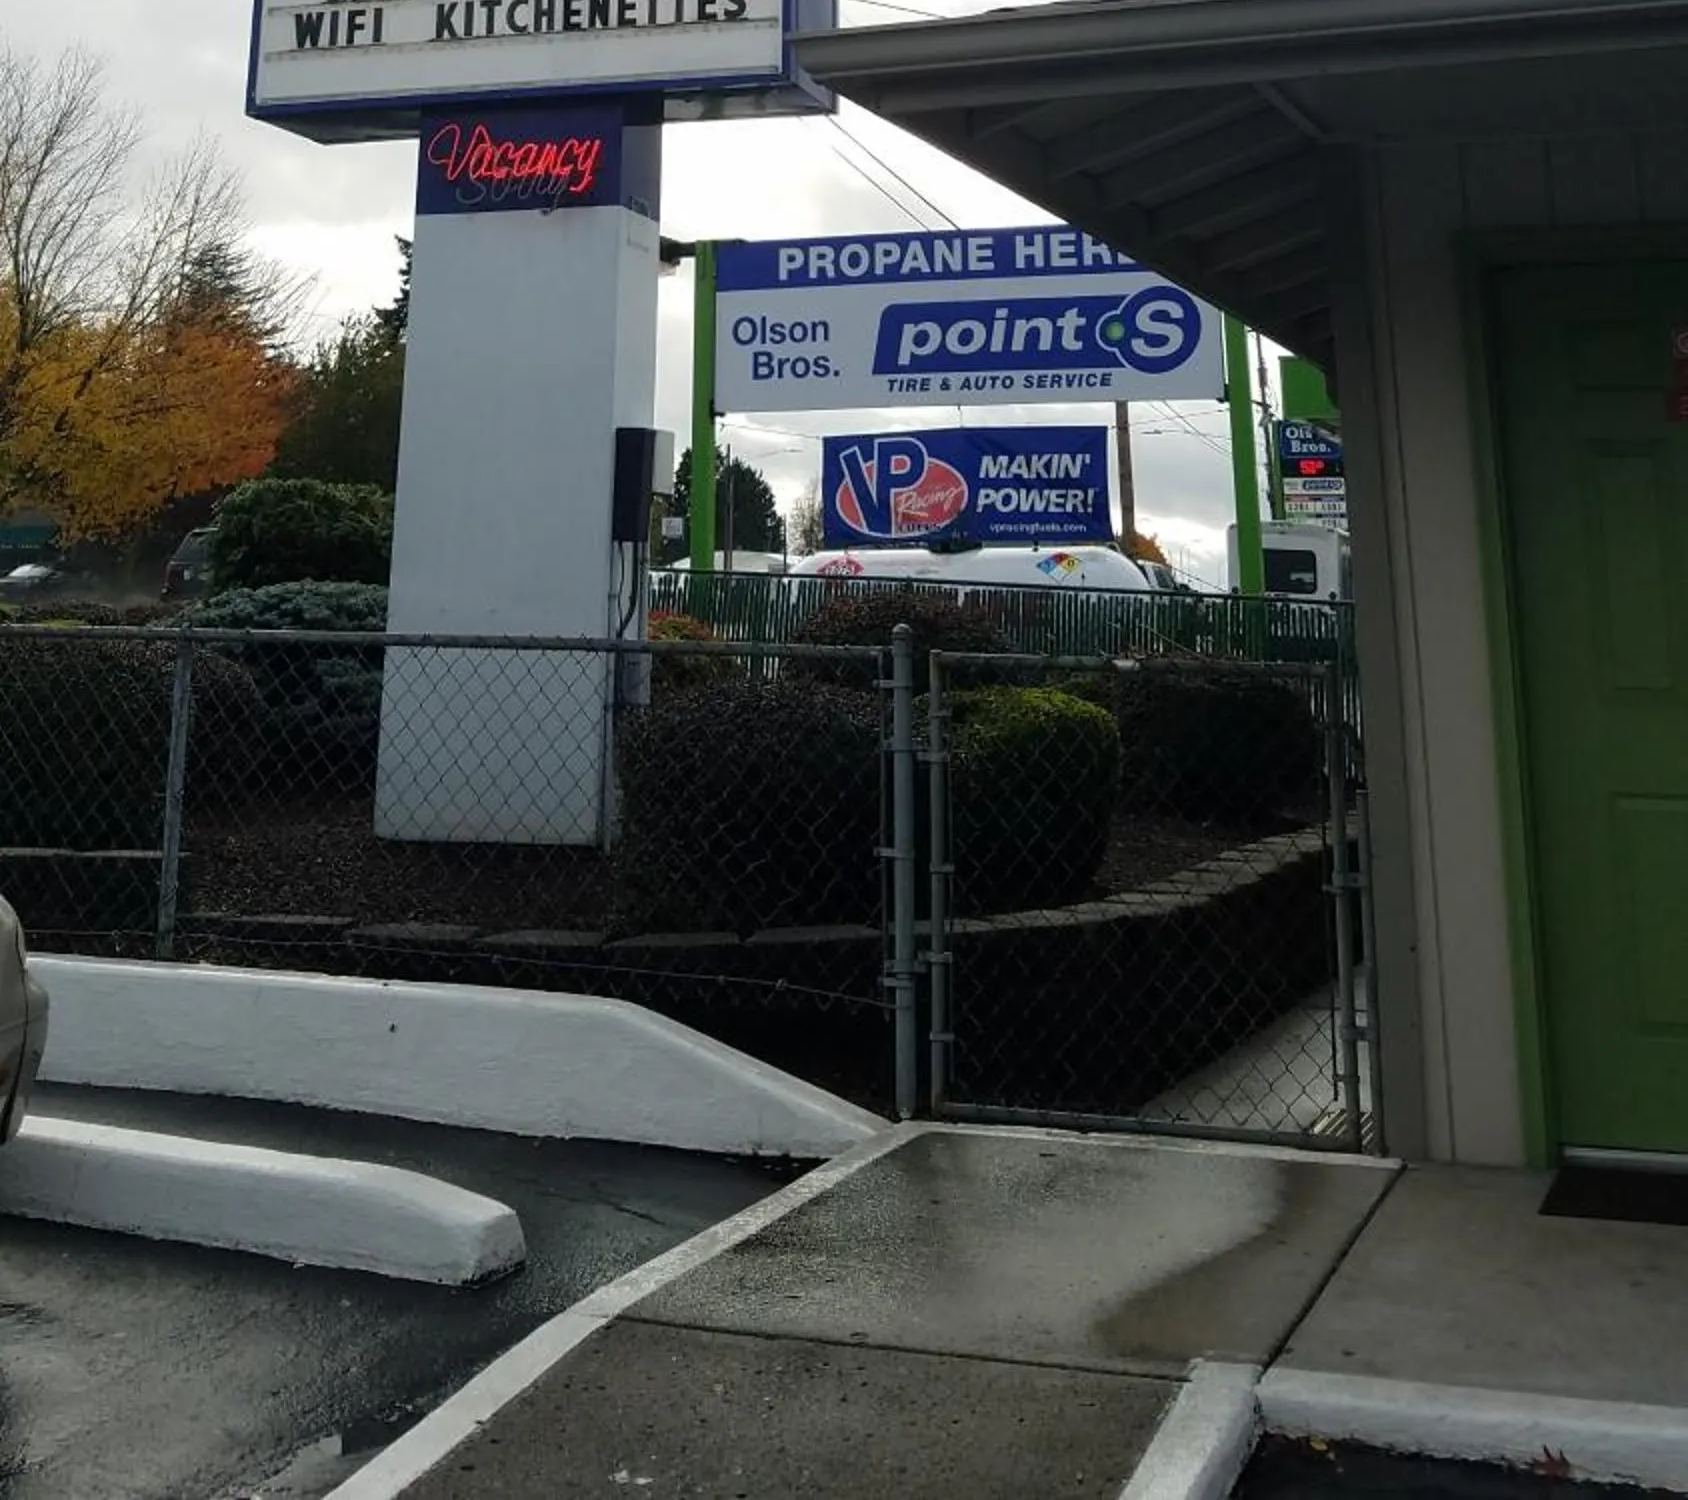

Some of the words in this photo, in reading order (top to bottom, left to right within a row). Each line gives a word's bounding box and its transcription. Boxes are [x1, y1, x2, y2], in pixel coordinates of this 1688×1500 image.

[295, 7, 384, 49] WIFI
[427, 123, 601, 193] Vacancy
[778, 237, 994, 281] PROPANE
[1015, 231, 1137, 269] HER
[732, 317, 829, 345] Olson
[898, 308, 1086, 365] point
[1131, 299, 1185, 357] S
[752, 352, 840, 380] Bros.
[887, 376, 931, 393] TIRE
[939, 376, 951, 391] &
[959, 373, 1014, 391] AUTO
[1023, 373, 1113, 389] SERVICE
[978, 453, 1091, 479] MAKIN'
[896, 486, 965, 513] Racing
[975, 487, 1095, 513] POWER!
